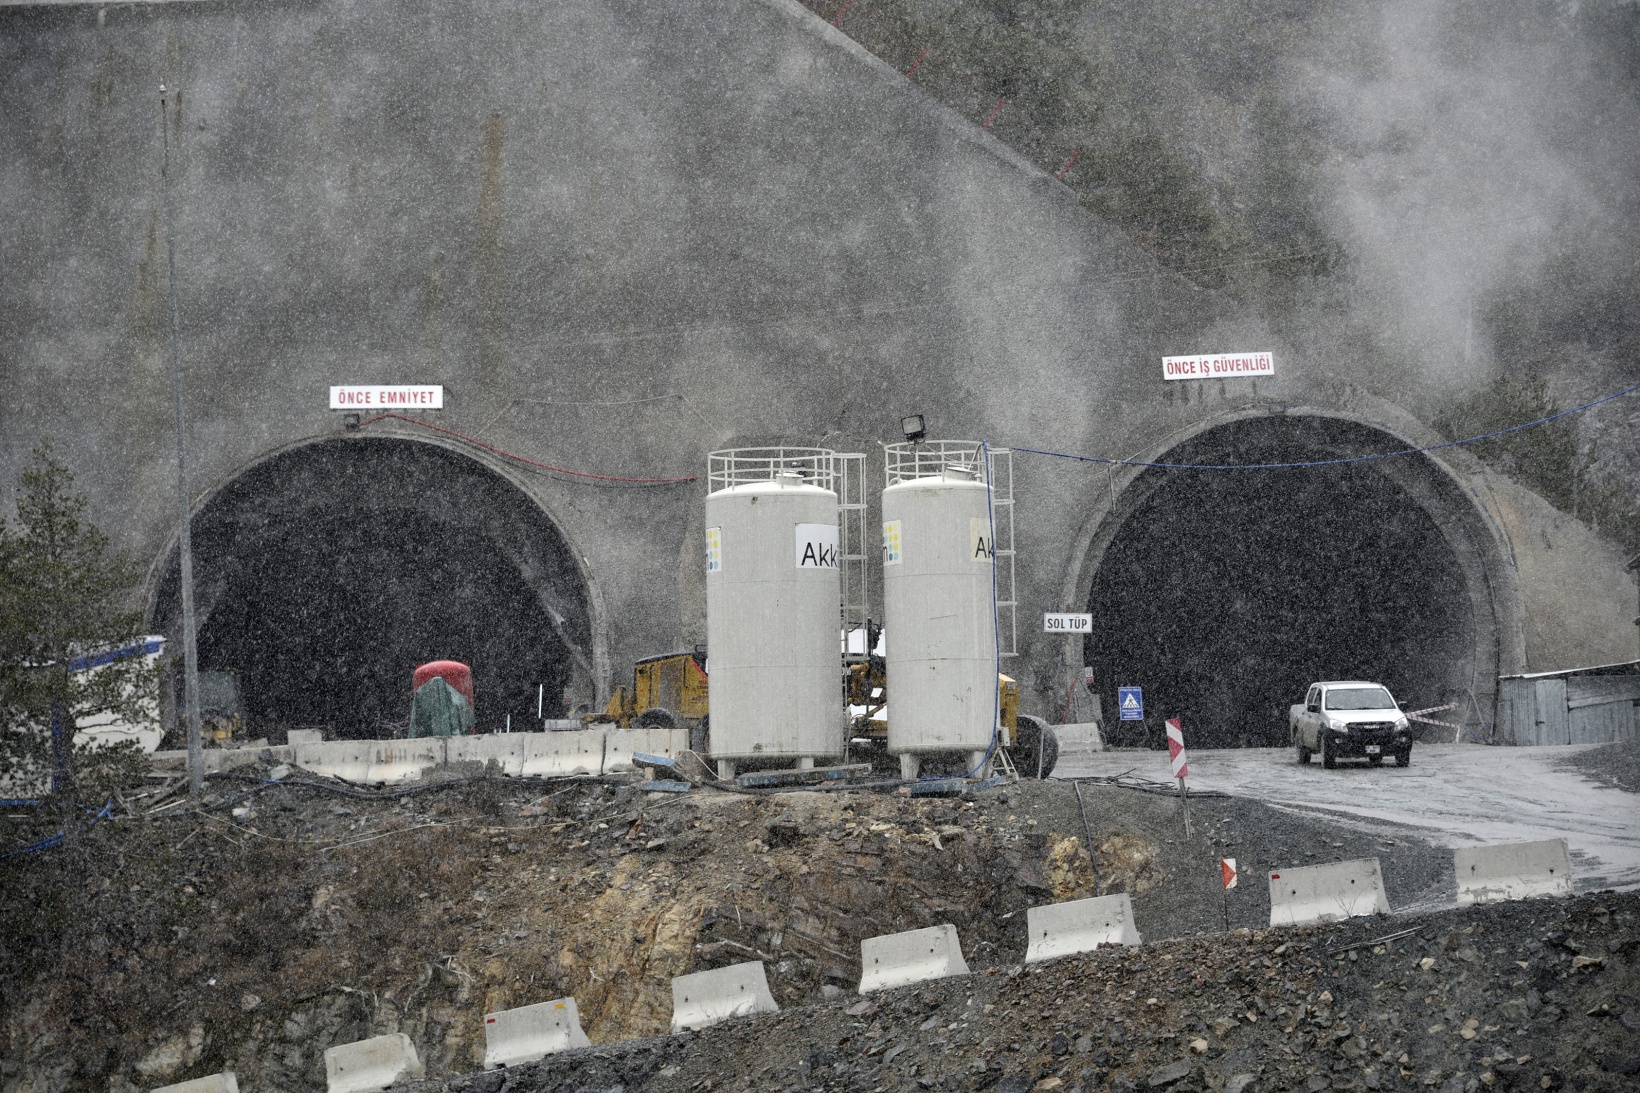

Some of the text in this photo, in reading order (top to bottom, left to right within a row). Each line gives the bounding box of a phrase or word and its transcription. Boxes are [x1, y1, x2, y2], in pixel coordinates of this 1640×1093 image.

[1166, 355, 1270, 376] ÖNCE İŞ GÜVENLİĞİ
[338, 388, 435, 404] ÖNCE EMNİYET
[1047, 616, 1088, 629] SOL TÜP
